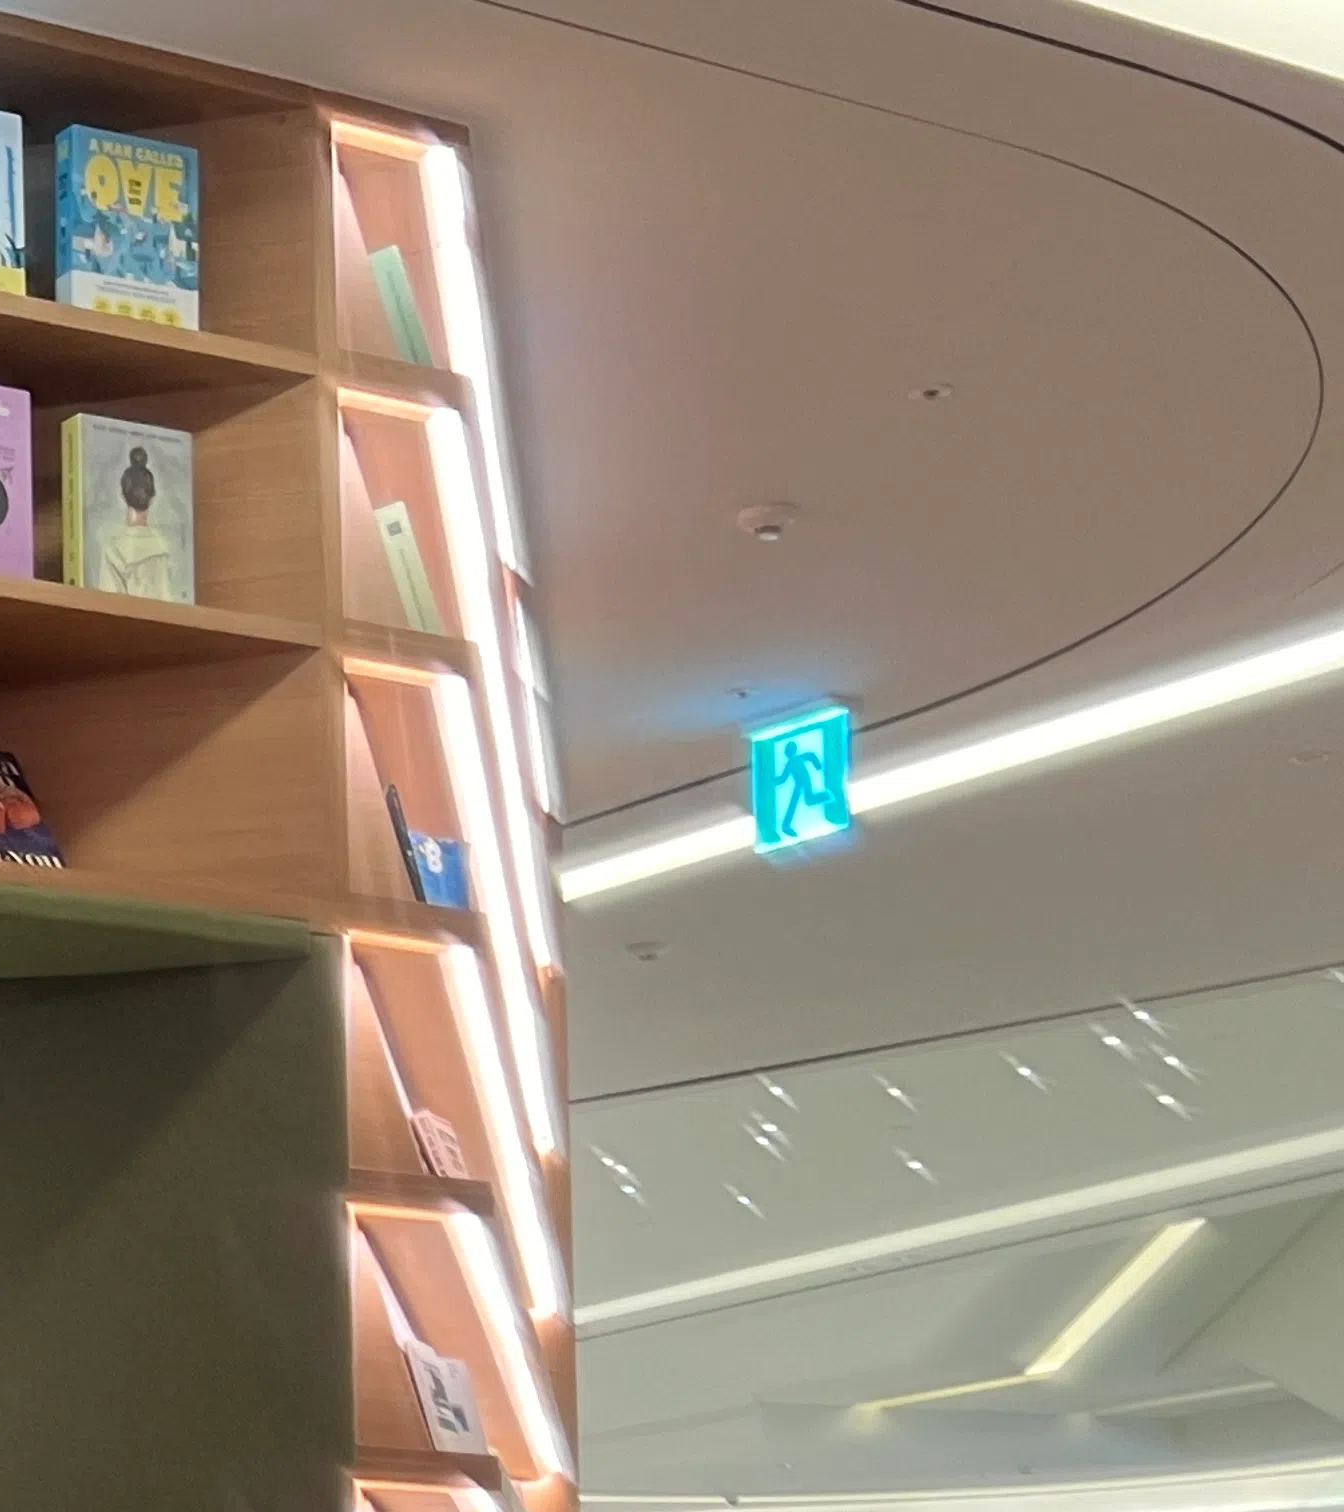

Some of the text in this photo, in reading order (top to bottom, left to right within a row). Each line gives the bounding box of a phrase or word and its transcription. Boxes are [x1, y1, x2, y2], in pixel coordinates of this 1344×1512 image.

[89, 139, 184, 168] A MAN CALLED
[85, 153, 185, 224] OVE
